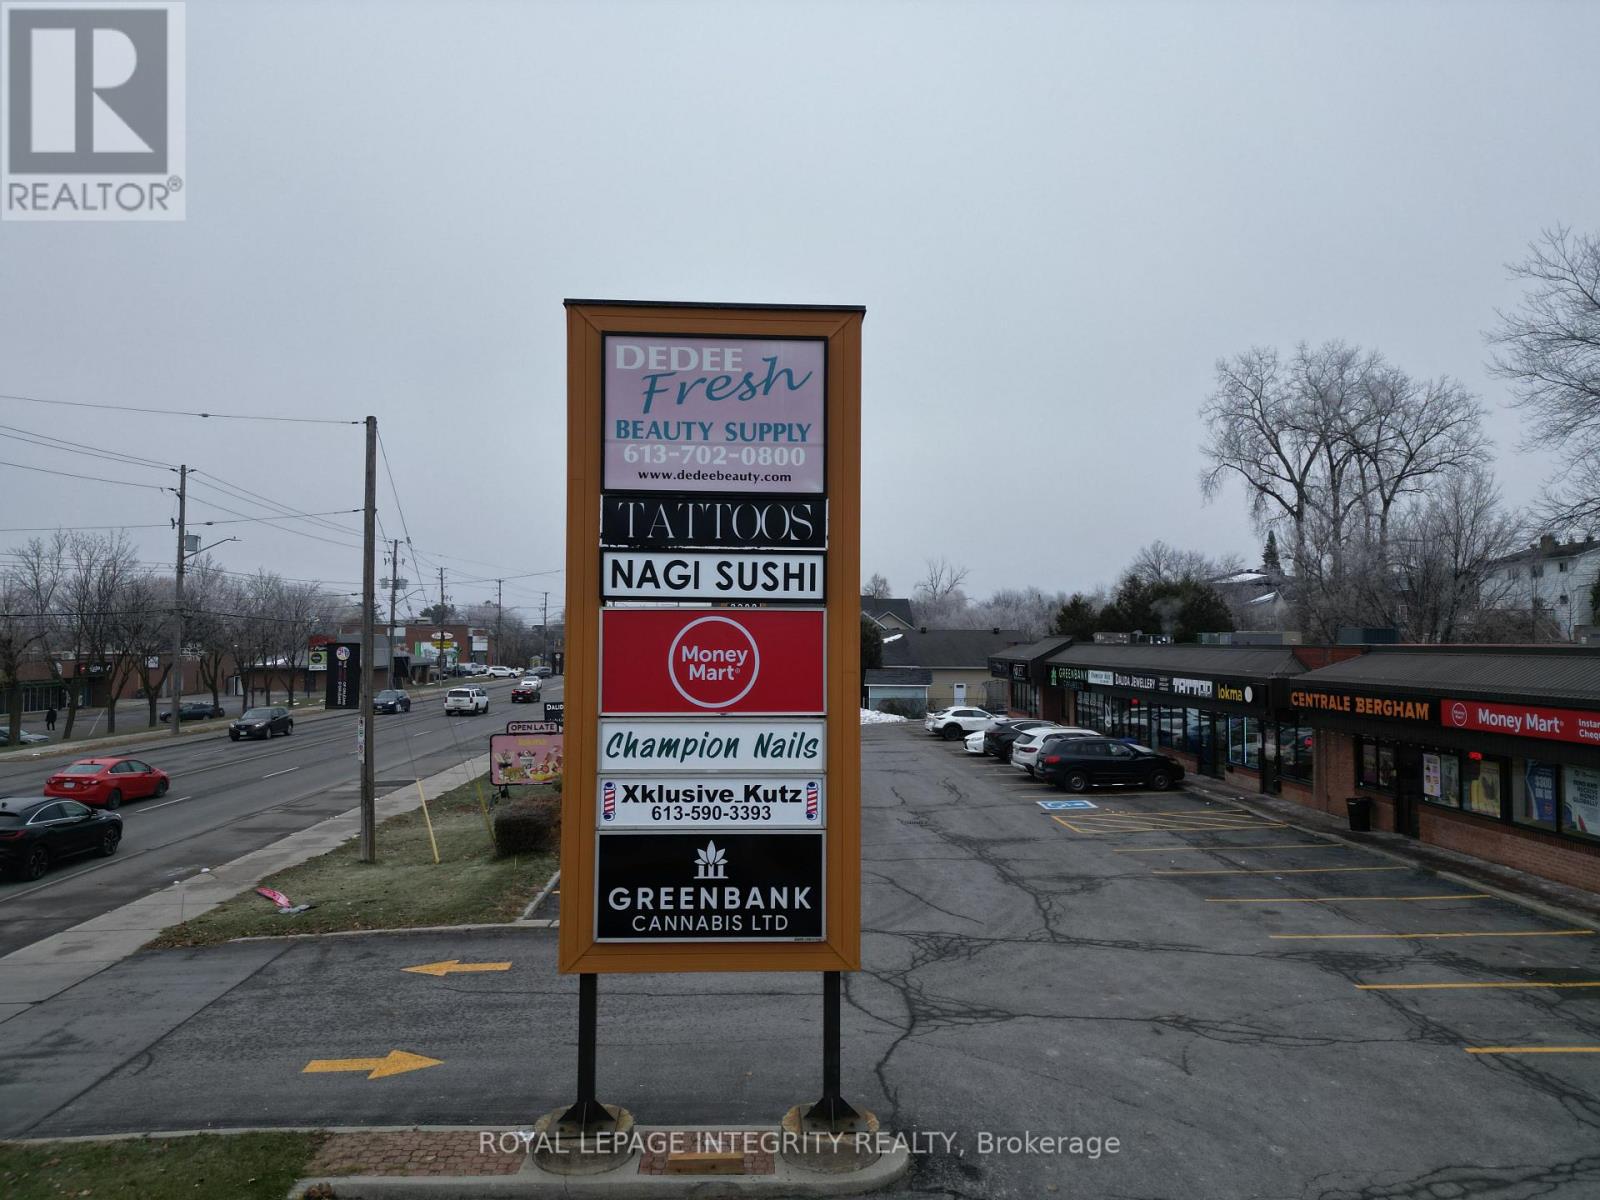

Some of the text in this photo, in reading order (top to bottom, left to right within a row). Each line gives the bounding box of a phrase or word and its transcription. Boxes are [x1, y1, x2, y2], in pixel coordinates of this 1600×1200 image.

[615, 344, 743, 372] DEDEE
[641, 356, 813, 415] Fresh
[615, 419, 812, 443] BEAUTY SUPPLY
[623, 444, 806, 466] 613-702-0800
[637, 469, 792, 484] www.dedeebeauty.com
[617, 501, 814, 541] TATTOOS
[611, 559, 816, 592] NAGI SUSHI
[681, 645, 748, 667] Money
[1218, 684, 1243, 702] lokma
[1291, 691, 1429, 721] CENTRALE BERGHAM
[511, 723, 555, 732] OPEN LATE
[1477, 708, 1522, 733] Money
[605, 731, 819, 763] Champion Nails
[1579, 729, 1600, 741] Cheq
[651, 805, 772, 822] 613-590-3393
[608, 886, 812, 911] GREENBANK
[632, 914, 789, 932] CANNABIS LTD
